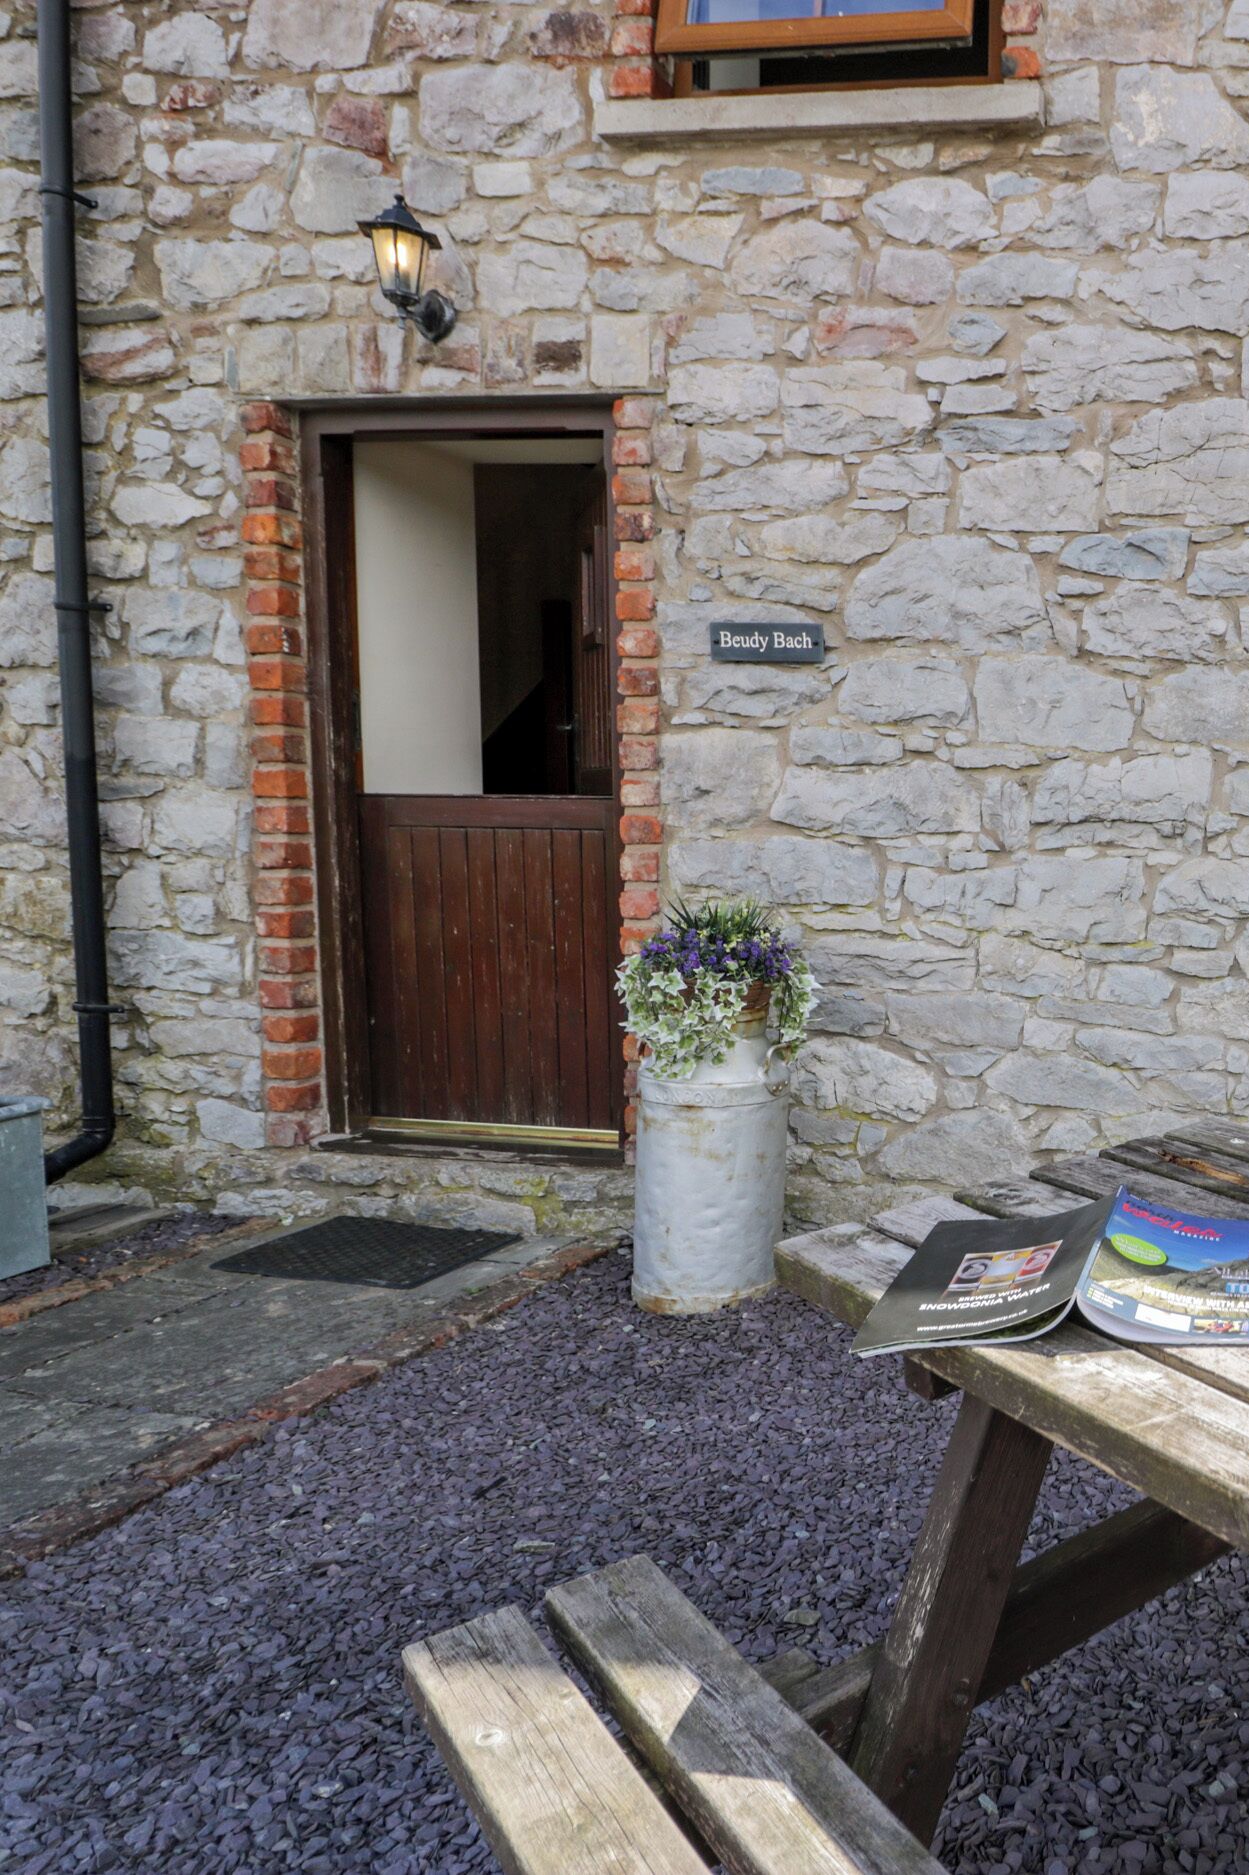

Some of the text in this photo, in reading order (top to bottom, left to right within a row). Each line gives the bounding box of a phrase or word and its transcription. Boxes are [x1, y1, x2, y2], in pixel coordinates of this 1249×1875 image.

[719, 631, 812, 652] Beudy Bach
[1173, 1229, 1220, 1241] MAGAZINE
[918, 1282, 1050, 1310] SNOWDONIA WATER
[958, 1286, 1021, 1302] BREWED WITH
[1143, 1284, 1202, 1306] INTERVIEW
[1206, 1298, 1234, 1308] WITH
